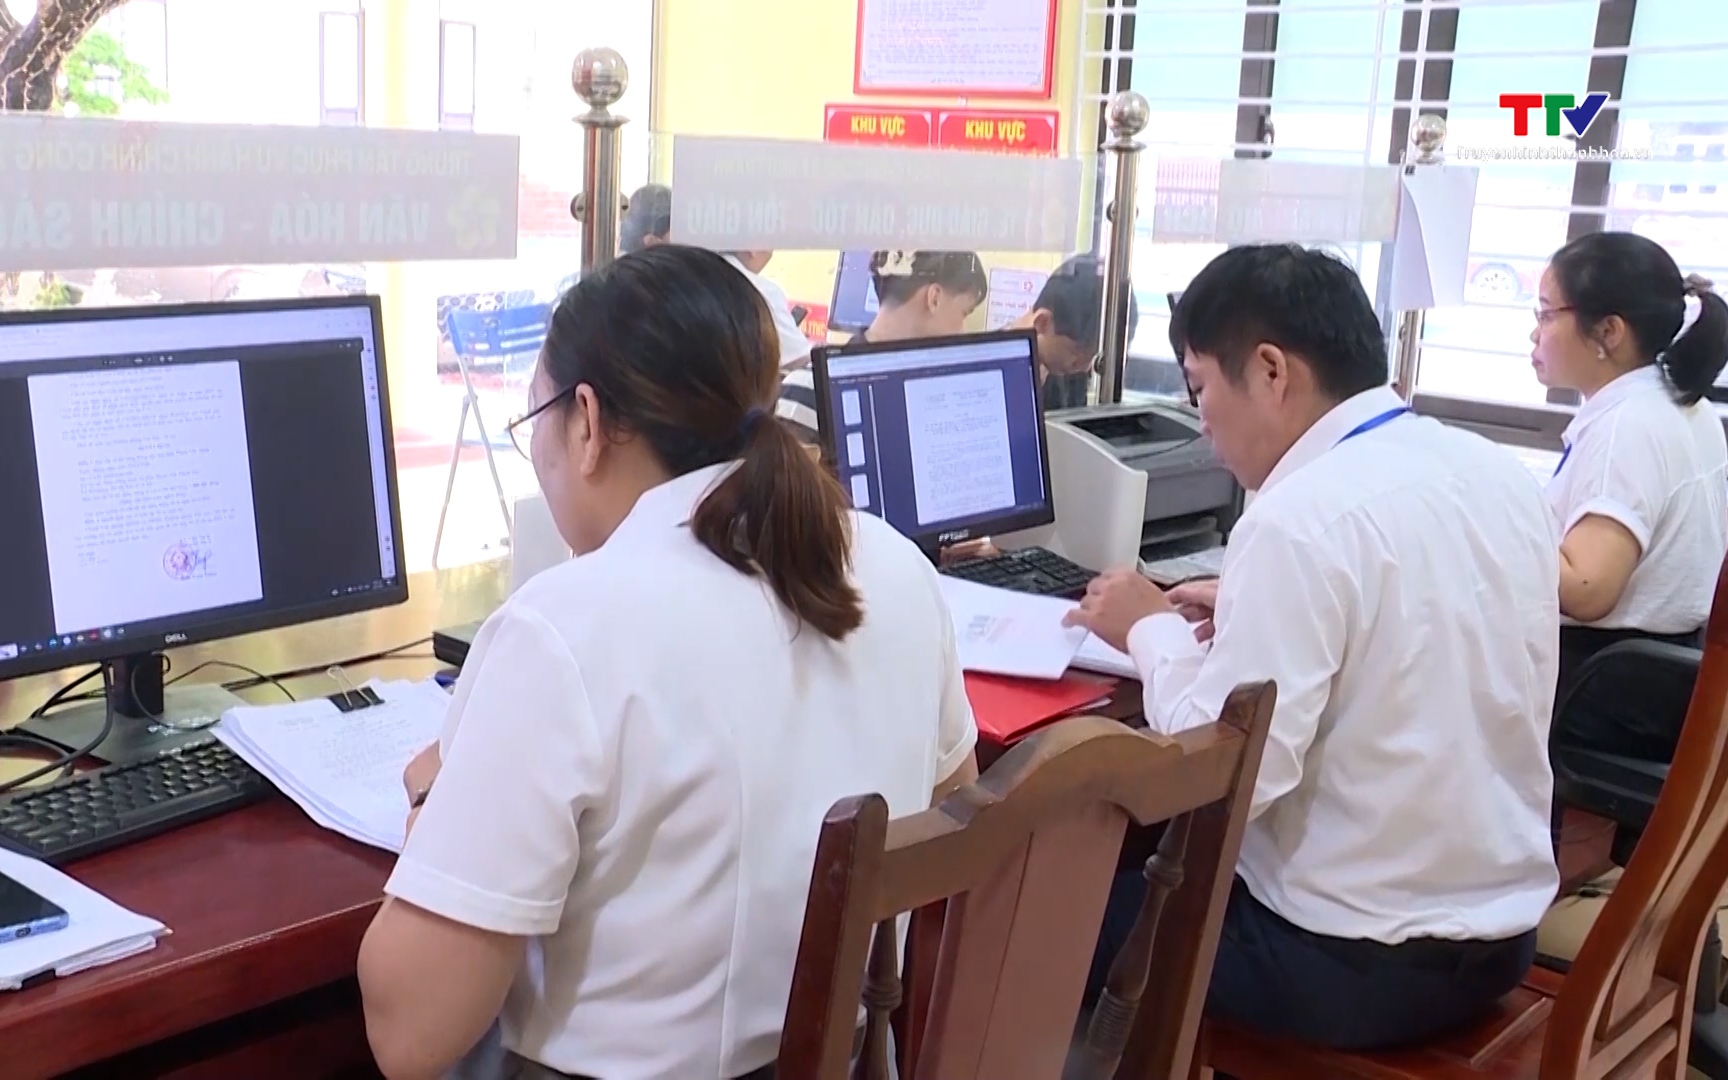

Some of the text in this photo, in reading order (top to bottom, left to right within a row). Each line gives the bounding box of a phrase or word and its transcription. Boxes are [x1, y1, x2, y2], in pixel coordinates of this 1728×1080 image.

[851, 115, 906, 140] KHU VỰC
[965, 119, 1026, 144] KHU VỰC
